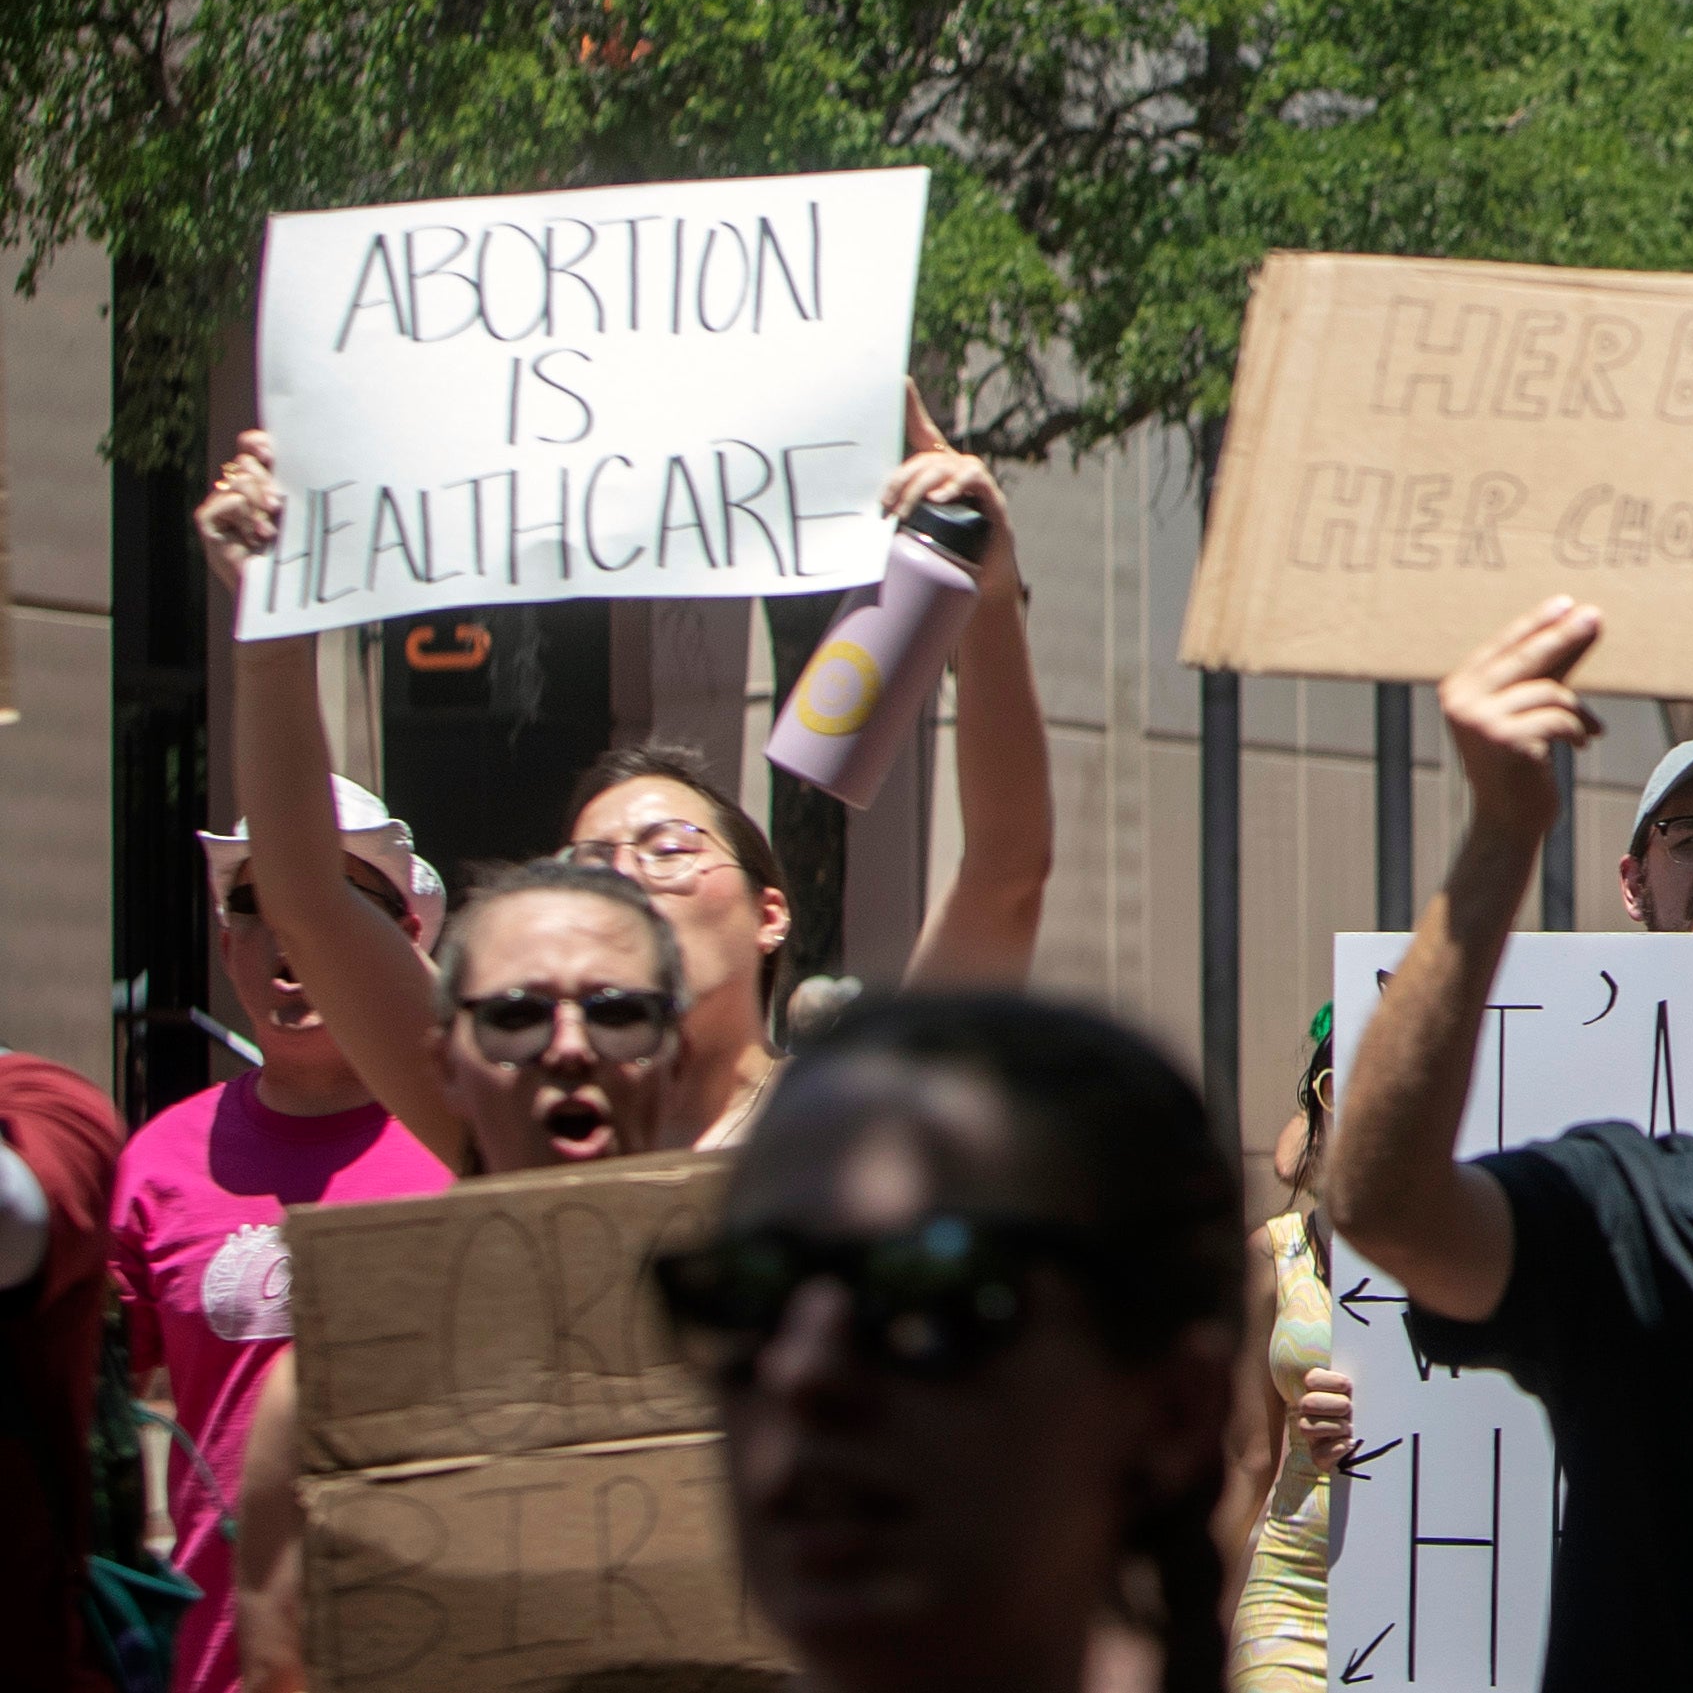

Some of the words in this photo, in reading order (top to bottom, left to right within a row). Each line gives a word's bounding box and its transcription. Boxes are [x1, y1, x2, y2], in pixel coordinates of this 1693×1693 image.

[336, 201, 822, 352] ABORTION
[507, 348, 595, 446] IS
[1371, 294, 1642, 421] HER
[267, 438, 863, 614] HEALTHCARE
[1286, 459, 1529, 573] HER
[300, 1198, 708, 1450] FORC
[303, 1472, 755, 1688] BIRT
